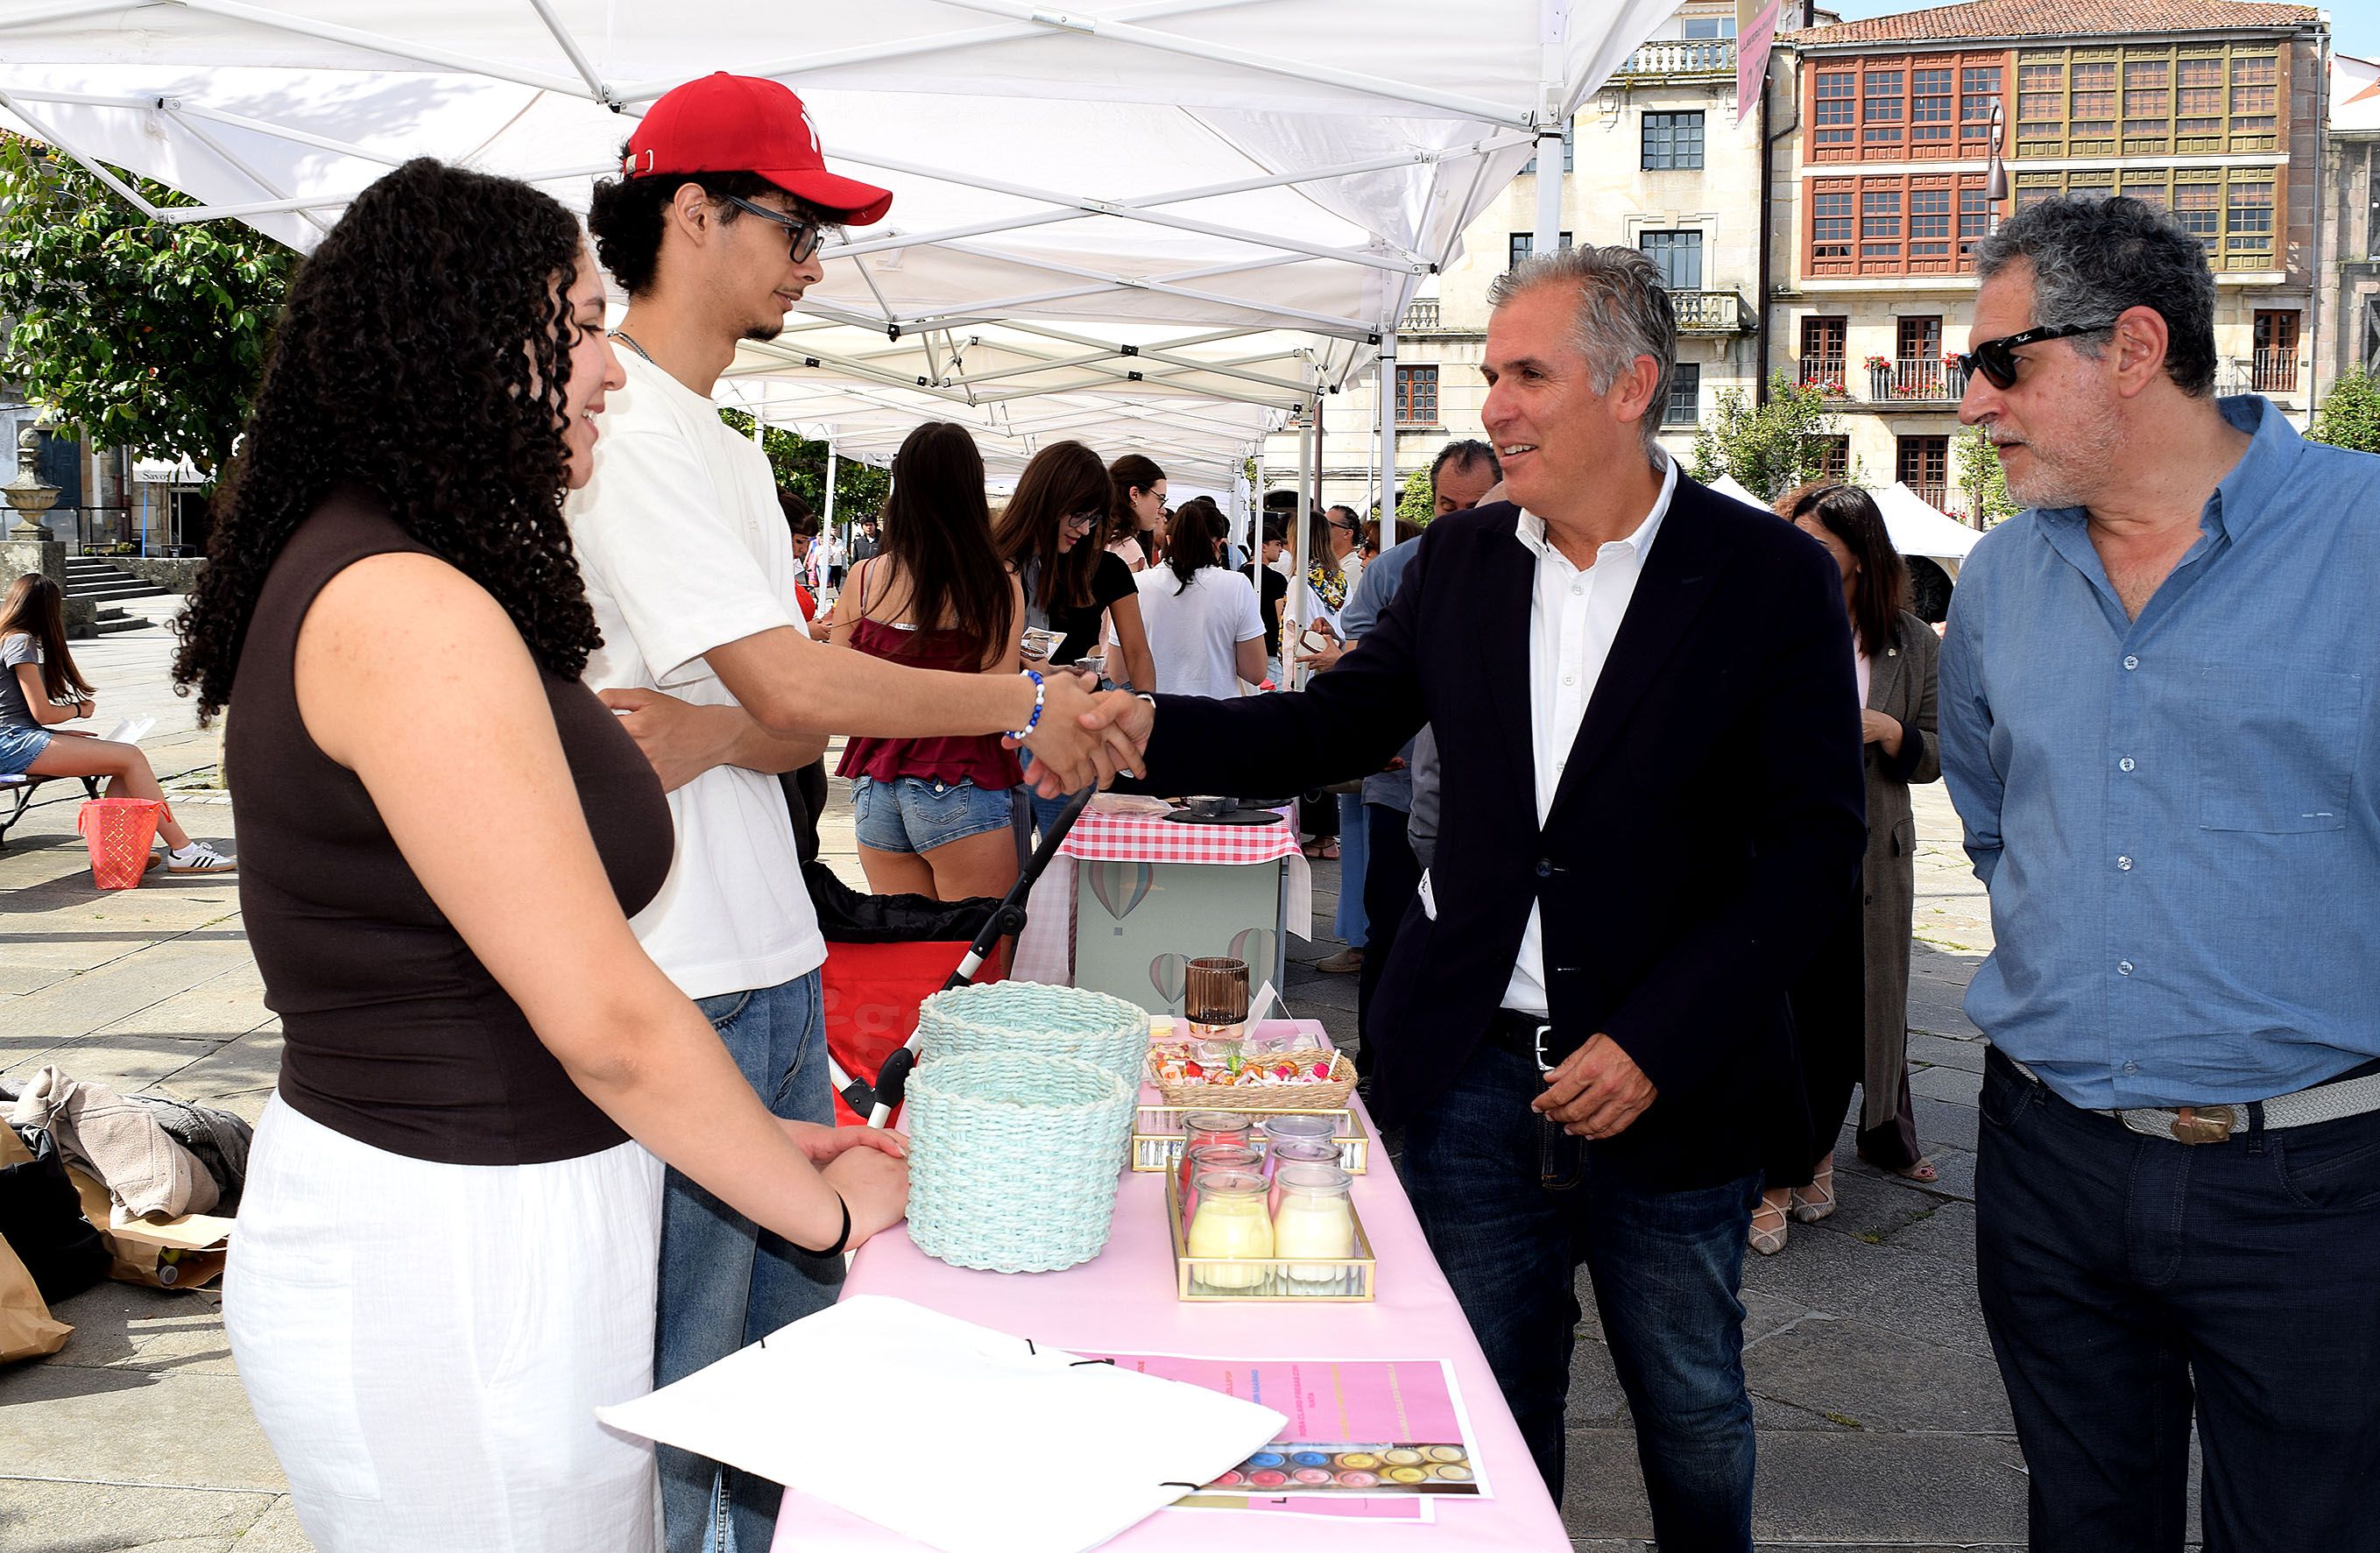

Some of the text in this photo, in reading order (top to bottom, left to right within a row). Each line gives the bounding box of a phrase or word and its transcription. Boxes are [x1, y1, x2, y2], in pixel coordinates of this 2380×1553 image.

[1293, 1376, 1303, 1399] FRESAS
[1296, 1400, 1305, 1421] CLARO
[1298, 1421, 1307, 1437] ROSA
